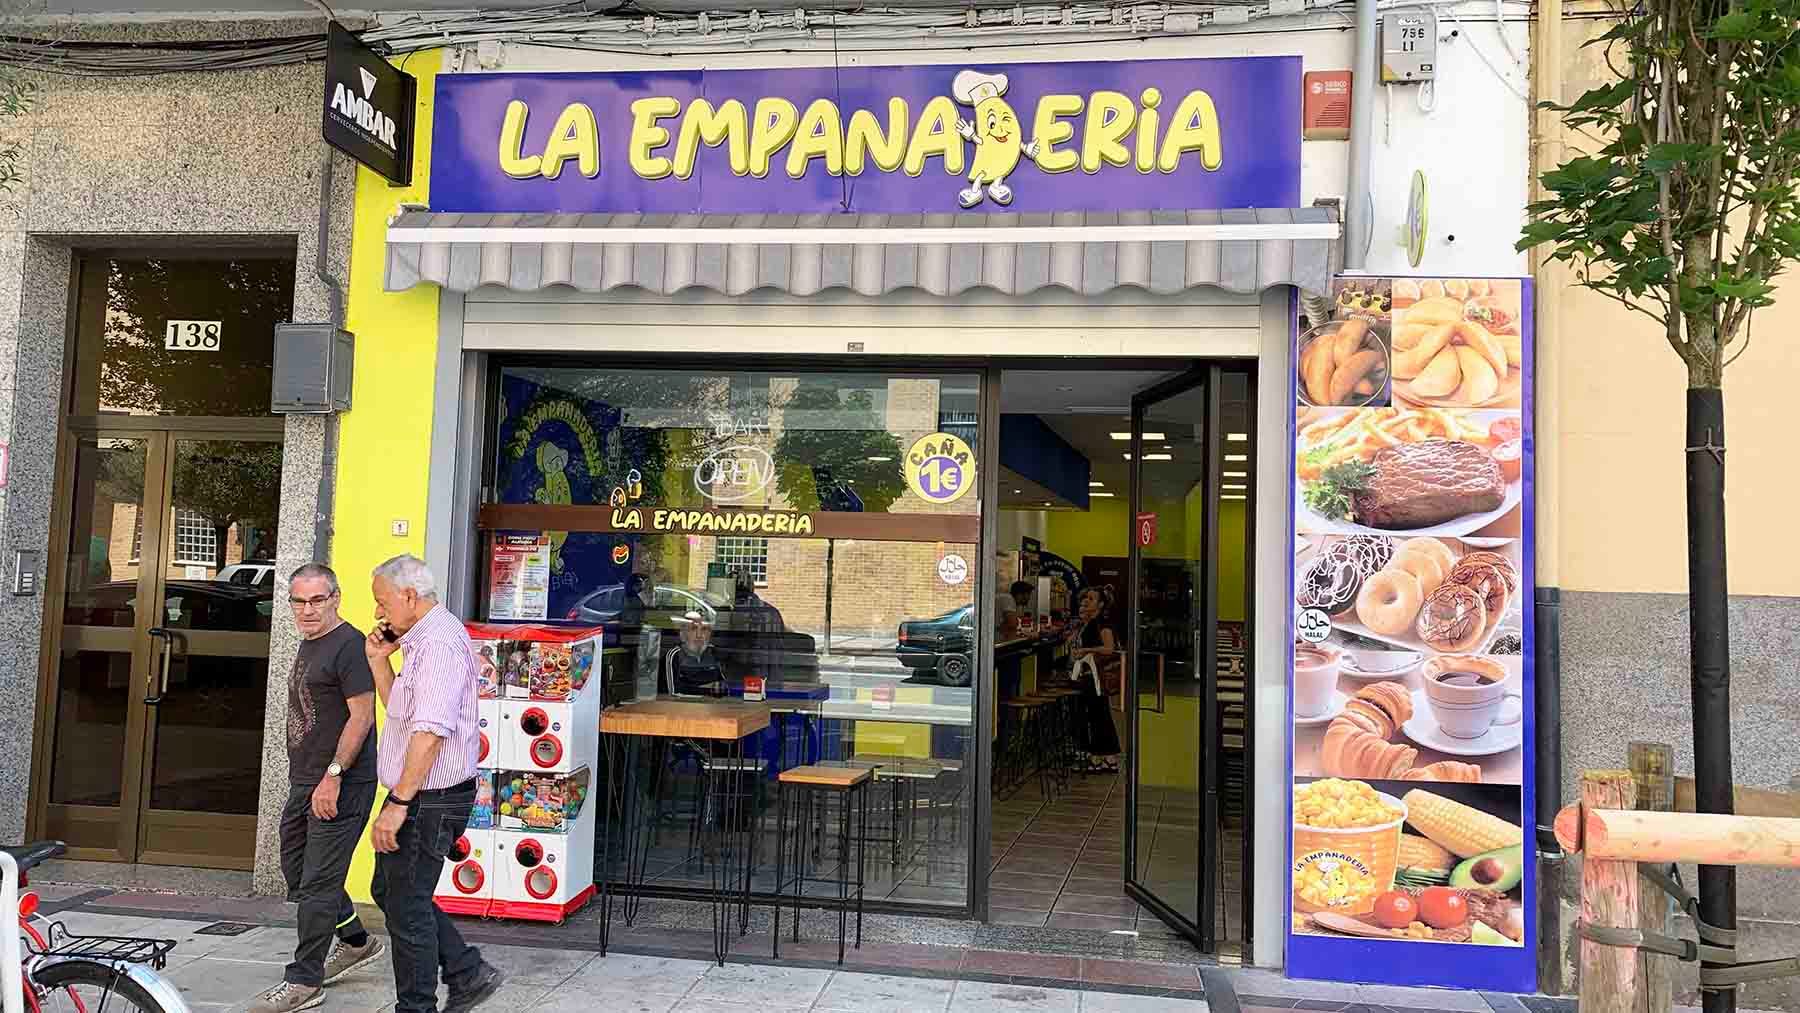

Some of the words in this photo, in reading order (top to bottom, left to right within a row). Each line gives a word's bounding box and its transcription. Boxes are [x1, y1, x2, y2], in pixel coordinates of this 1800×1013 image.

[330, 82, 397, 151] AMBAR
[499, 99, 602, 181] LA
[168, 323, 219, 348] 138
[910, 438, 969, 466] CAÑA
[697, 456, 772, 485] OPEN
[919, 459, 959, 493] 1€
[611, 508, 643, 530] LA
[940, 558, 966, 574] حلال
[1299, 612, 1329, 630] حلال
[1305, 631, 1323, 639] HALAL
